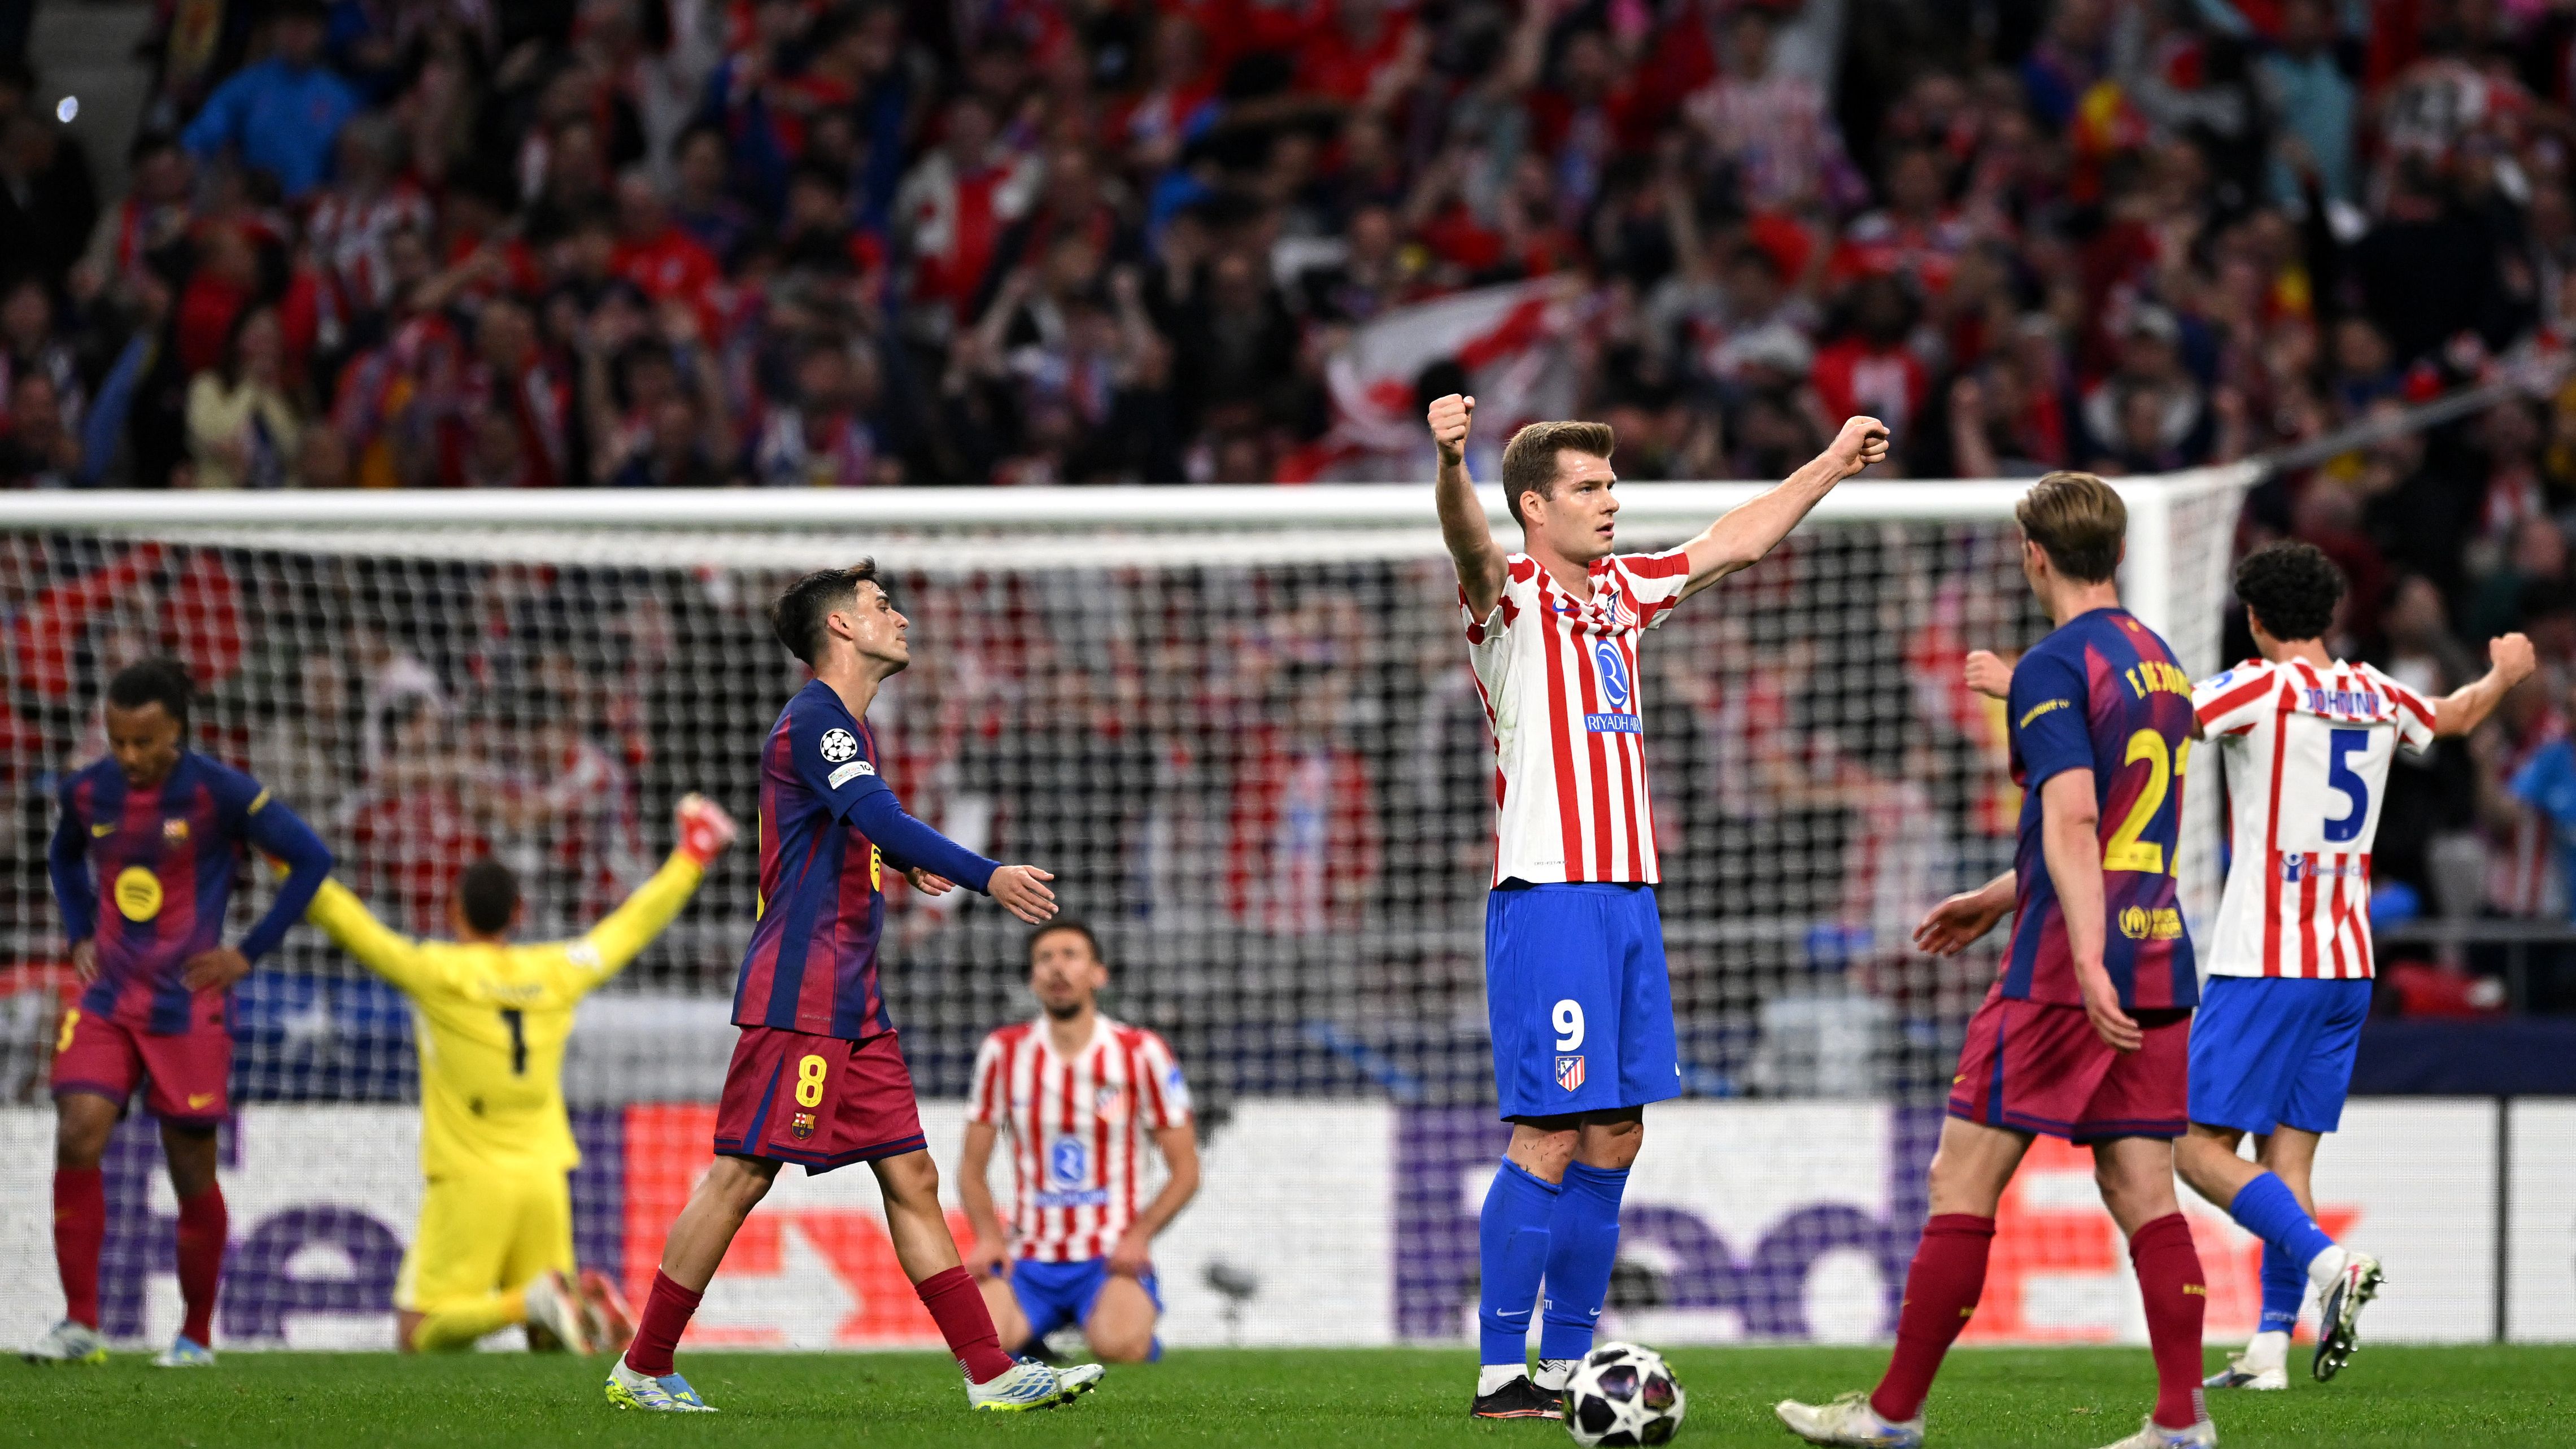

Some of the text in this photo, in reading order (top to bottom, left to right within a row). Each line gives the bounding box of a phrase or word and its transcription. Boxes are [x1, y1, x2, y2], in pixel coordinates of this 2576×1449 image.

[1588, 715, 1641, 731] RIYADH AIR
[2324, 728, 2369, 843] 5
[499, 1009, 526, 1074] 1
[1552, 999, 1585, 1051] 9
[795, 1054, 827, 1107] 8
[96, 1104, 1008, 1344] FeEx
